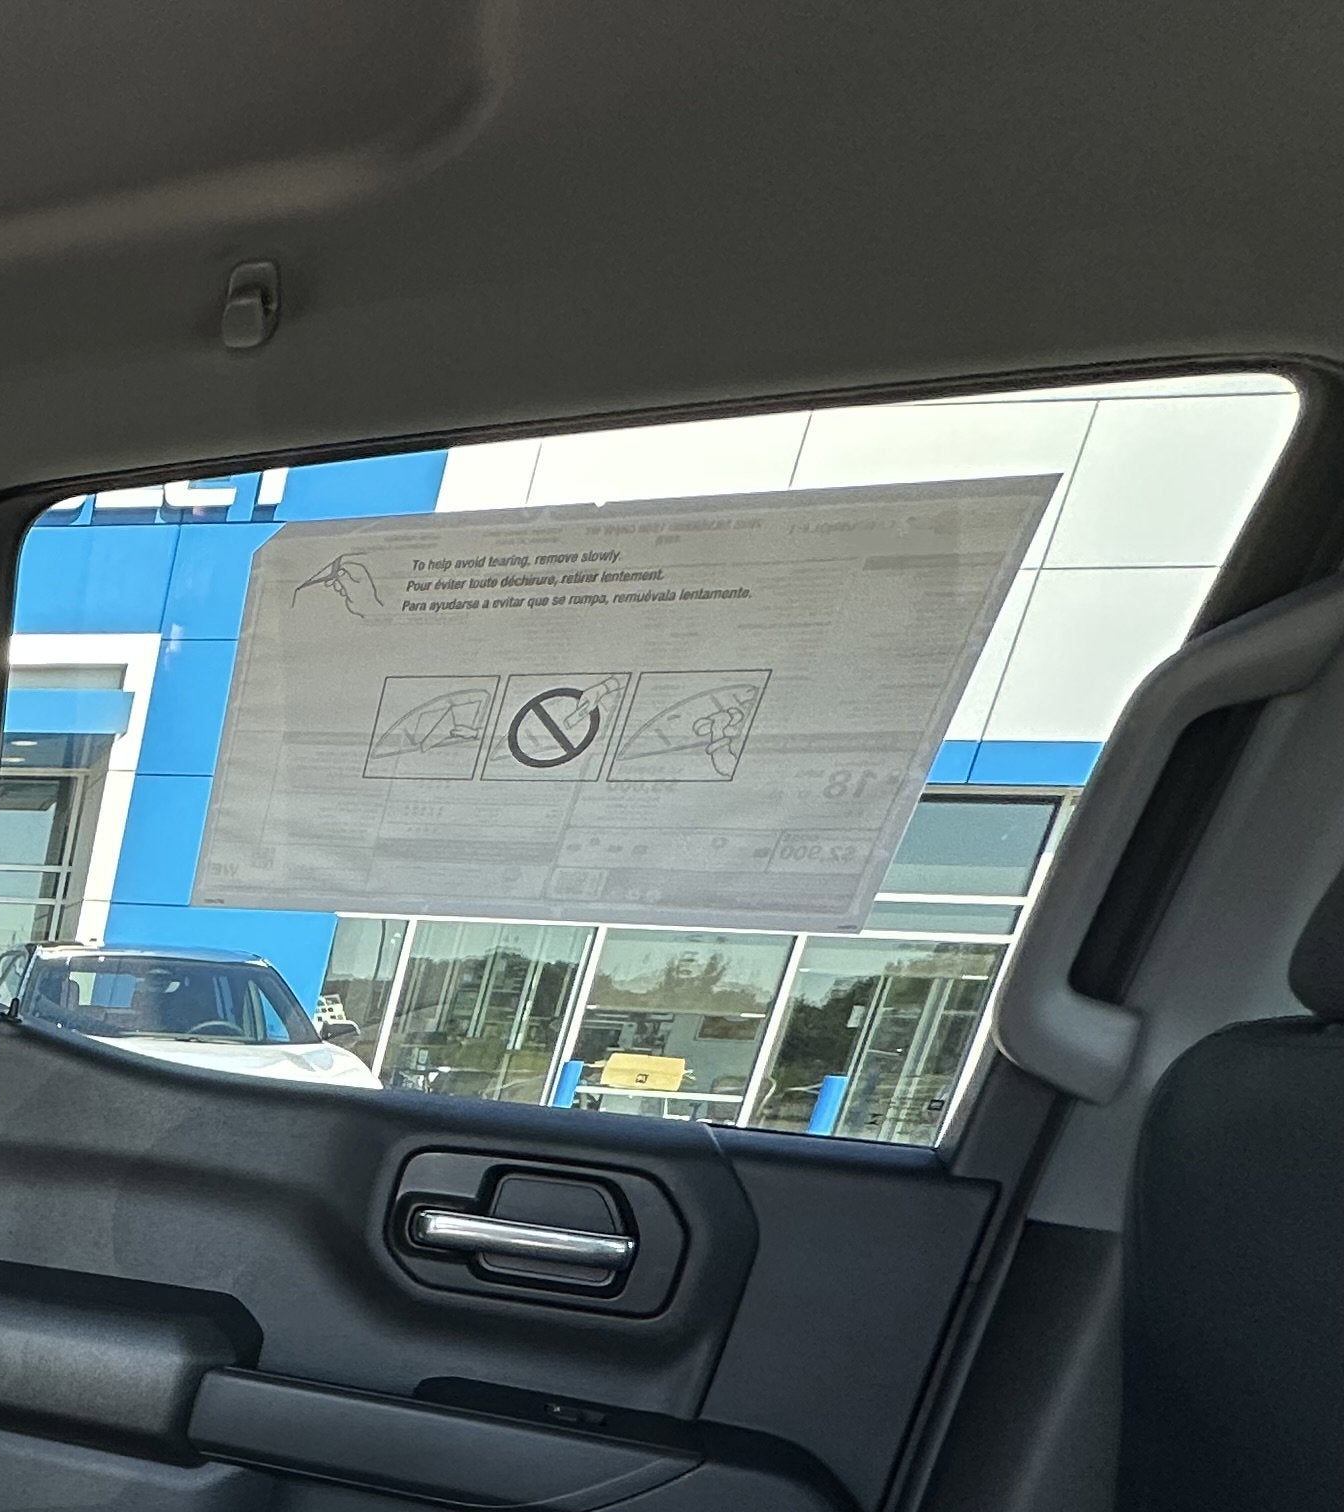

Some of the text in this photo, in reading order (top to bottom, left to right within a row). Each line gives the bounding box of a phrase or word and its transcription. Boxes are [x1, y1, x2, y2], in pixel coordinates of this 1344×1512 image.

[412, 559, 426, 571] To
[428, 557, 452, 571] help
[454, 555, 486, 569] avoid
[534, 551, 579, 566] remove
[406, 580, 431, 592] Pour
[434, 578, 466, 591] éviter
[468, 577, 498, 589] toute
[500, 574, 559, 588] déchirure,
[561, 571, 598, 585] retirer
[401, 586, 753, 613] Para ayudarse a evitar que se rompa, remuévala lentamente.
